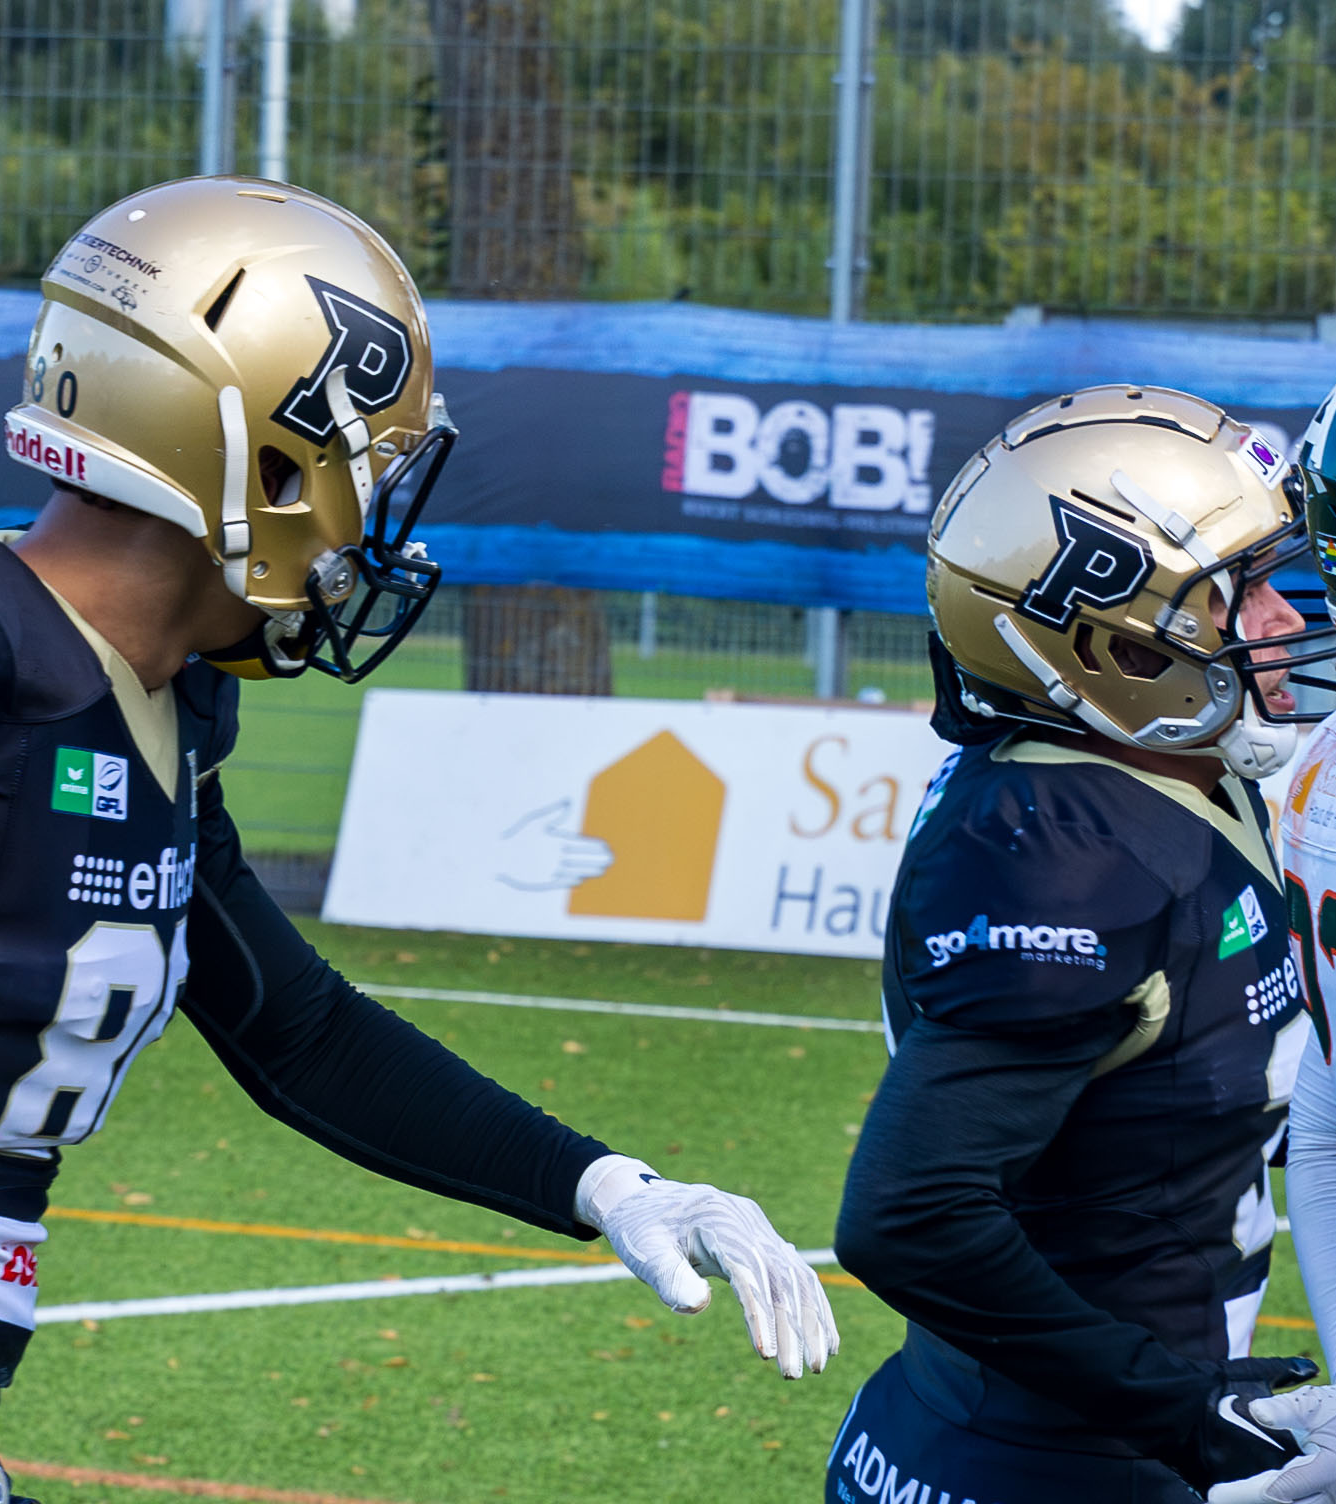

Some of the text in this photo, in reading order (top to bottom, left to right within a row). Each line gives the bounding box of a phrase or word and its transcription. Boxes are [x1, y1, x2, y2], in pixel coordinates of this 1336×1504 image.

[683, 391, 935, 514] BOB!
[1014, 494, 1157, 632] P
[1020, 952, 1106, 971] marketing
